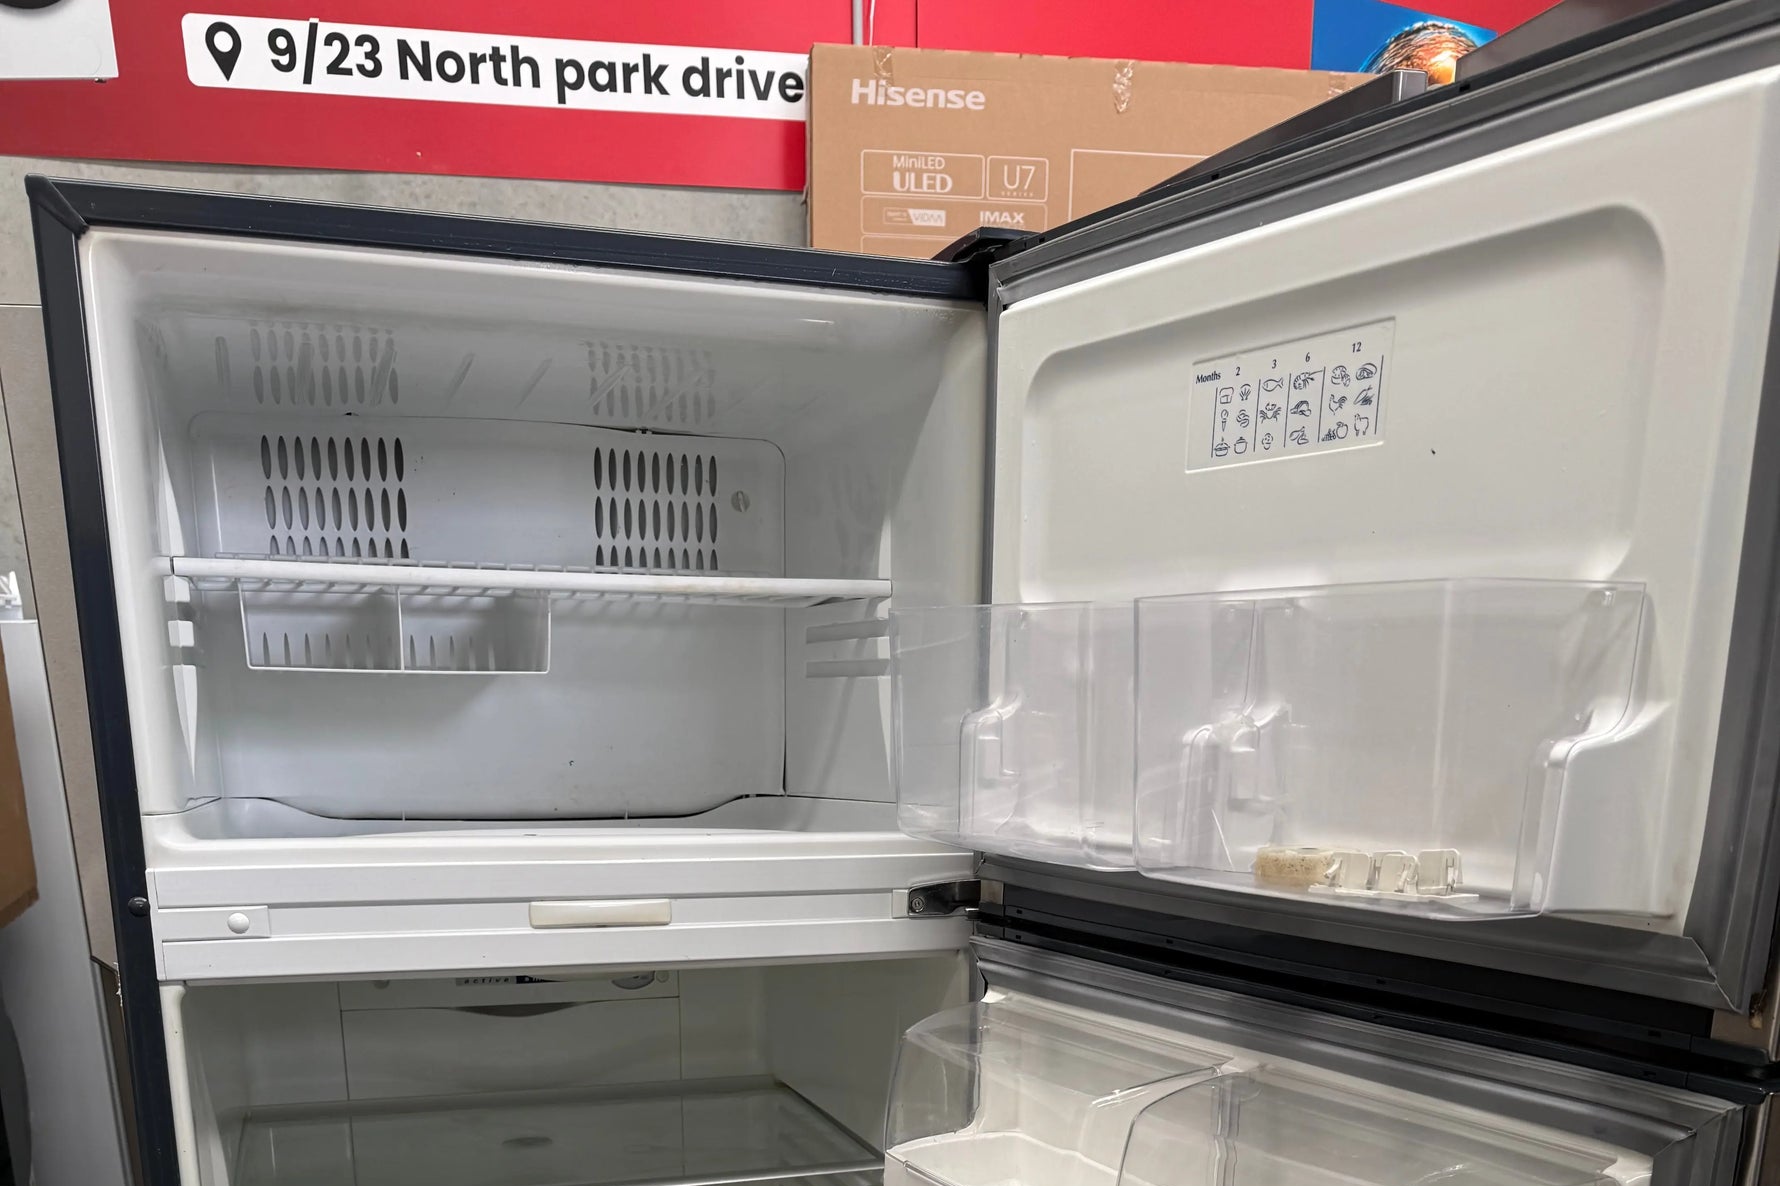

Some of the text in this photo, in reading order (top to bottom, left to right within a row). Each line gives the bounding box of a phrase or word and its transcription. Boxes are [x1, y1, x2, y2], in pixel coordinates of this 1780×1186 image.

[267, 21, 804, 104] 9/23 North park drive
[851, 78, 986, 111] Hisense
[893, 155, 945, 170] MiniLED
[893, 171, 953, 193] ULED
[1003, 165, 1036, 190] U7
[980, 210, 1025, 224] IMAX
[1195, 341, 1362, 384] Months 2 3 6 12
